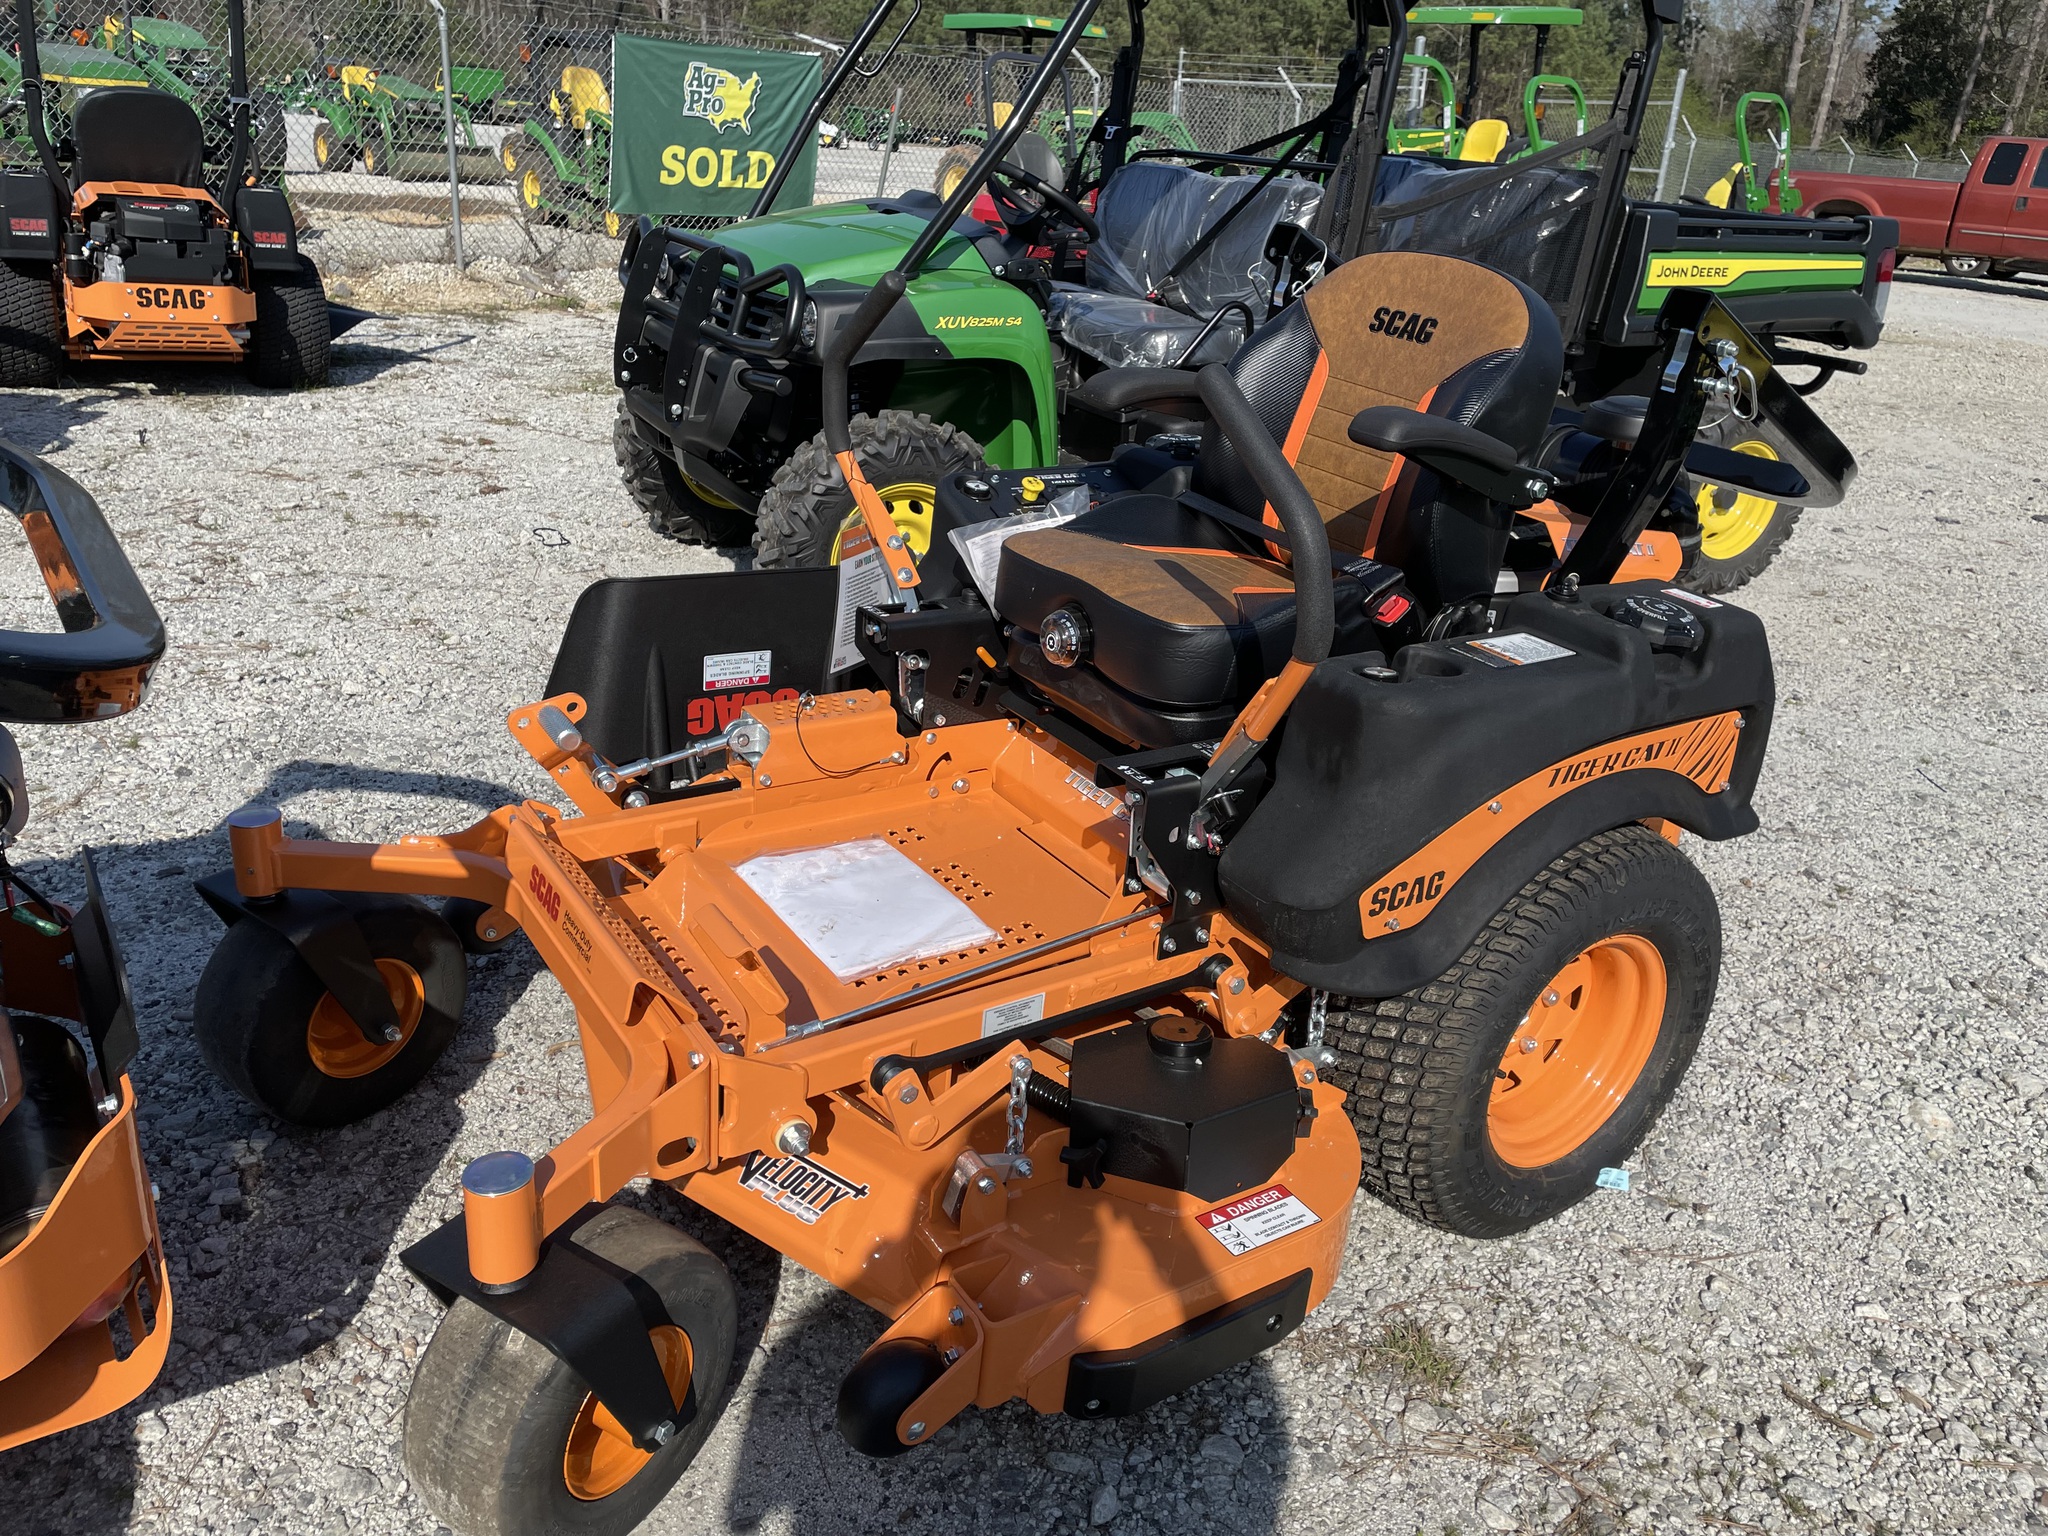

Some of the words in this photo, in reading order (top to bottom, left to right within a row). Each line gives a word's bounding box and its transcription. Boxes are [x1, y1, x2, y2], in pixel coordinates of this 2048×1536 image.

[687, 66, 726, 92] Ag-
[686, 89, 724, 114] Pro
[660, 145, 776, 189] SOLD
[10, 218, 47, 231] SCAG
[253, 231, 286, 243] SCAG
[1657, 265, 1688, 278] JOHN
[1691, 265, 1729, 278] DEERE
[136, 287, 206, 310] SCAG
[934, 316, 1004, 329] XUV825M
[1005, 316, 1023, 326] S4
[1369, 306, 1439, 345] SCAG
[1628, 542, 1644, 556] AT
[715, 677, 750, 688] DANGER
[1548, 752, 1622, 788] TIGER
[1621, 738, 1670, 768] CAT
[1064, 769, 1115, 809] TIGER
[530, 864, 561, 922] SCAG
[1368, 870, 1446, 917] SCAG
[562, 921, 592, 964] Commercial
[563, 909, 593, 951] Heavy-Duty
[739, 1150, 851, 1213] VELOCITY
[745, 1176, 822, 1224] PLUS
[1226, 1190, 1283, 1217] DANGER
[1243, 1210, 1269, 1223] SPINNING
[1268, 1202, 1289, 1213] BLADES
[1255, 1229, 1268, 1237] BLADE
[1268, 1222, 1286, 1232] CONTACT
[1261, 1217, 1273, 1225] KEEP
[1272, 1212, 1286, 1220] CLEAR
